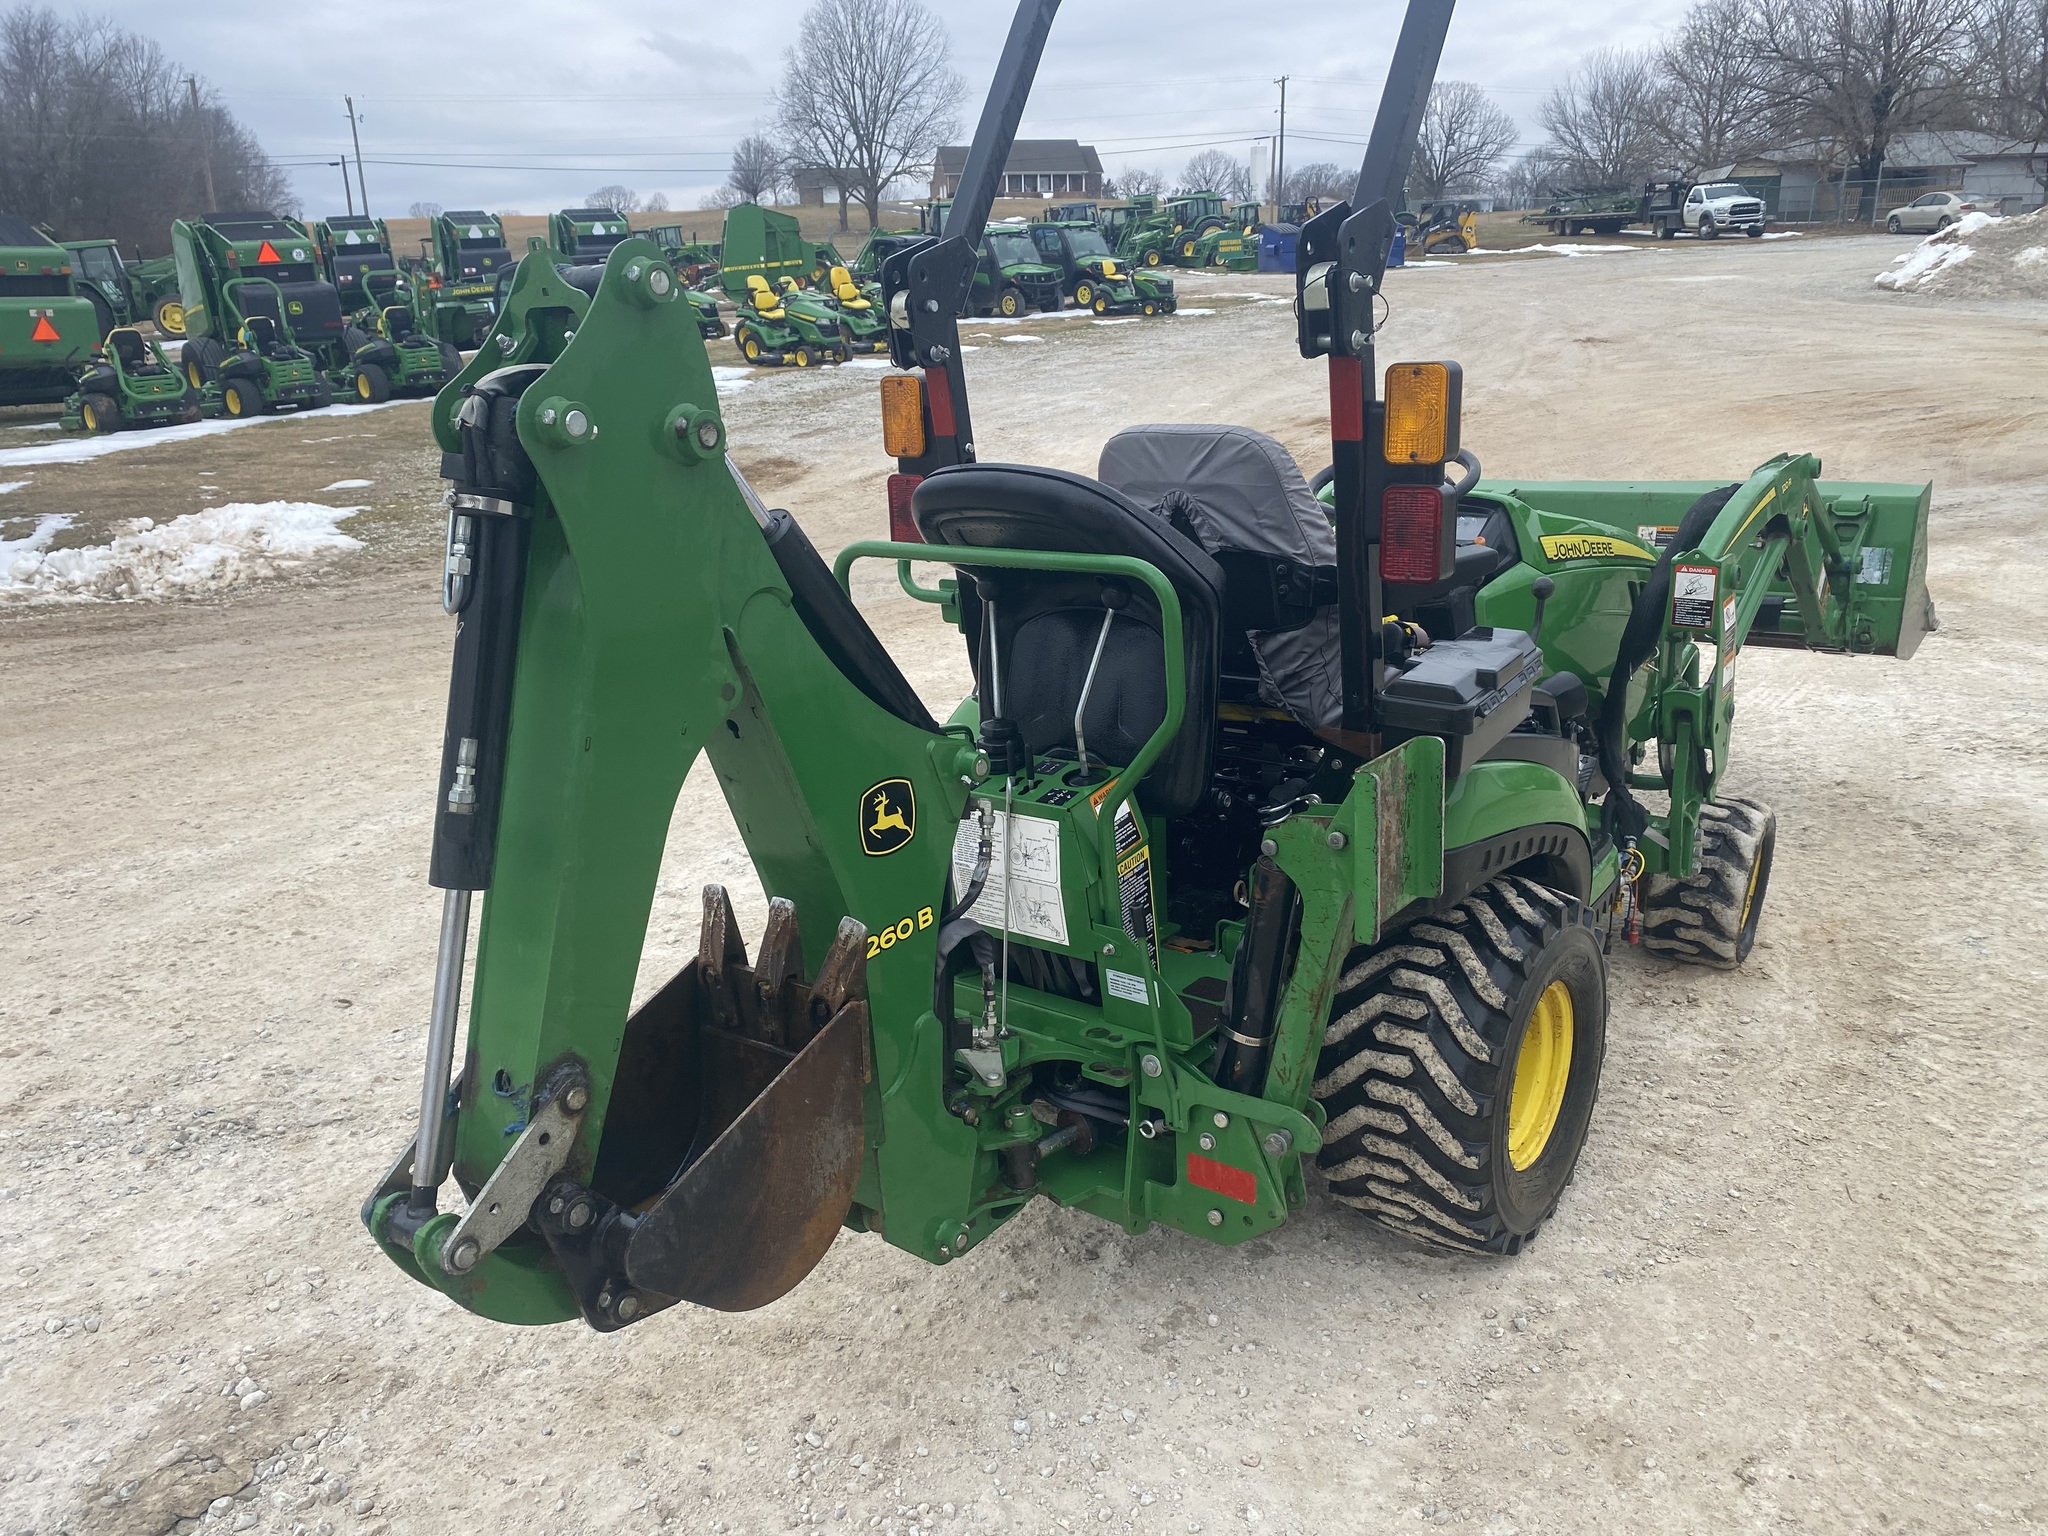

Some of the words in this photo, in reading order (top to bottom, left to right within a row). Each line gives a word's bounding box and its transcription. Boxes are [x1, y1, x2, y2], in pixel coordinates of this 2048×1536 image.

[452, 288, 470, 296] JOHN
[470, 285, 494, 293] DEERE
[1553, 541, 1582, 559] JOHN
[1582, 539, 1614, 557] DEERE
[1119, 850, 1145, 875] CAUTION
[866, 916, 914, 960] 260
[917, 905, 933, 933] B
